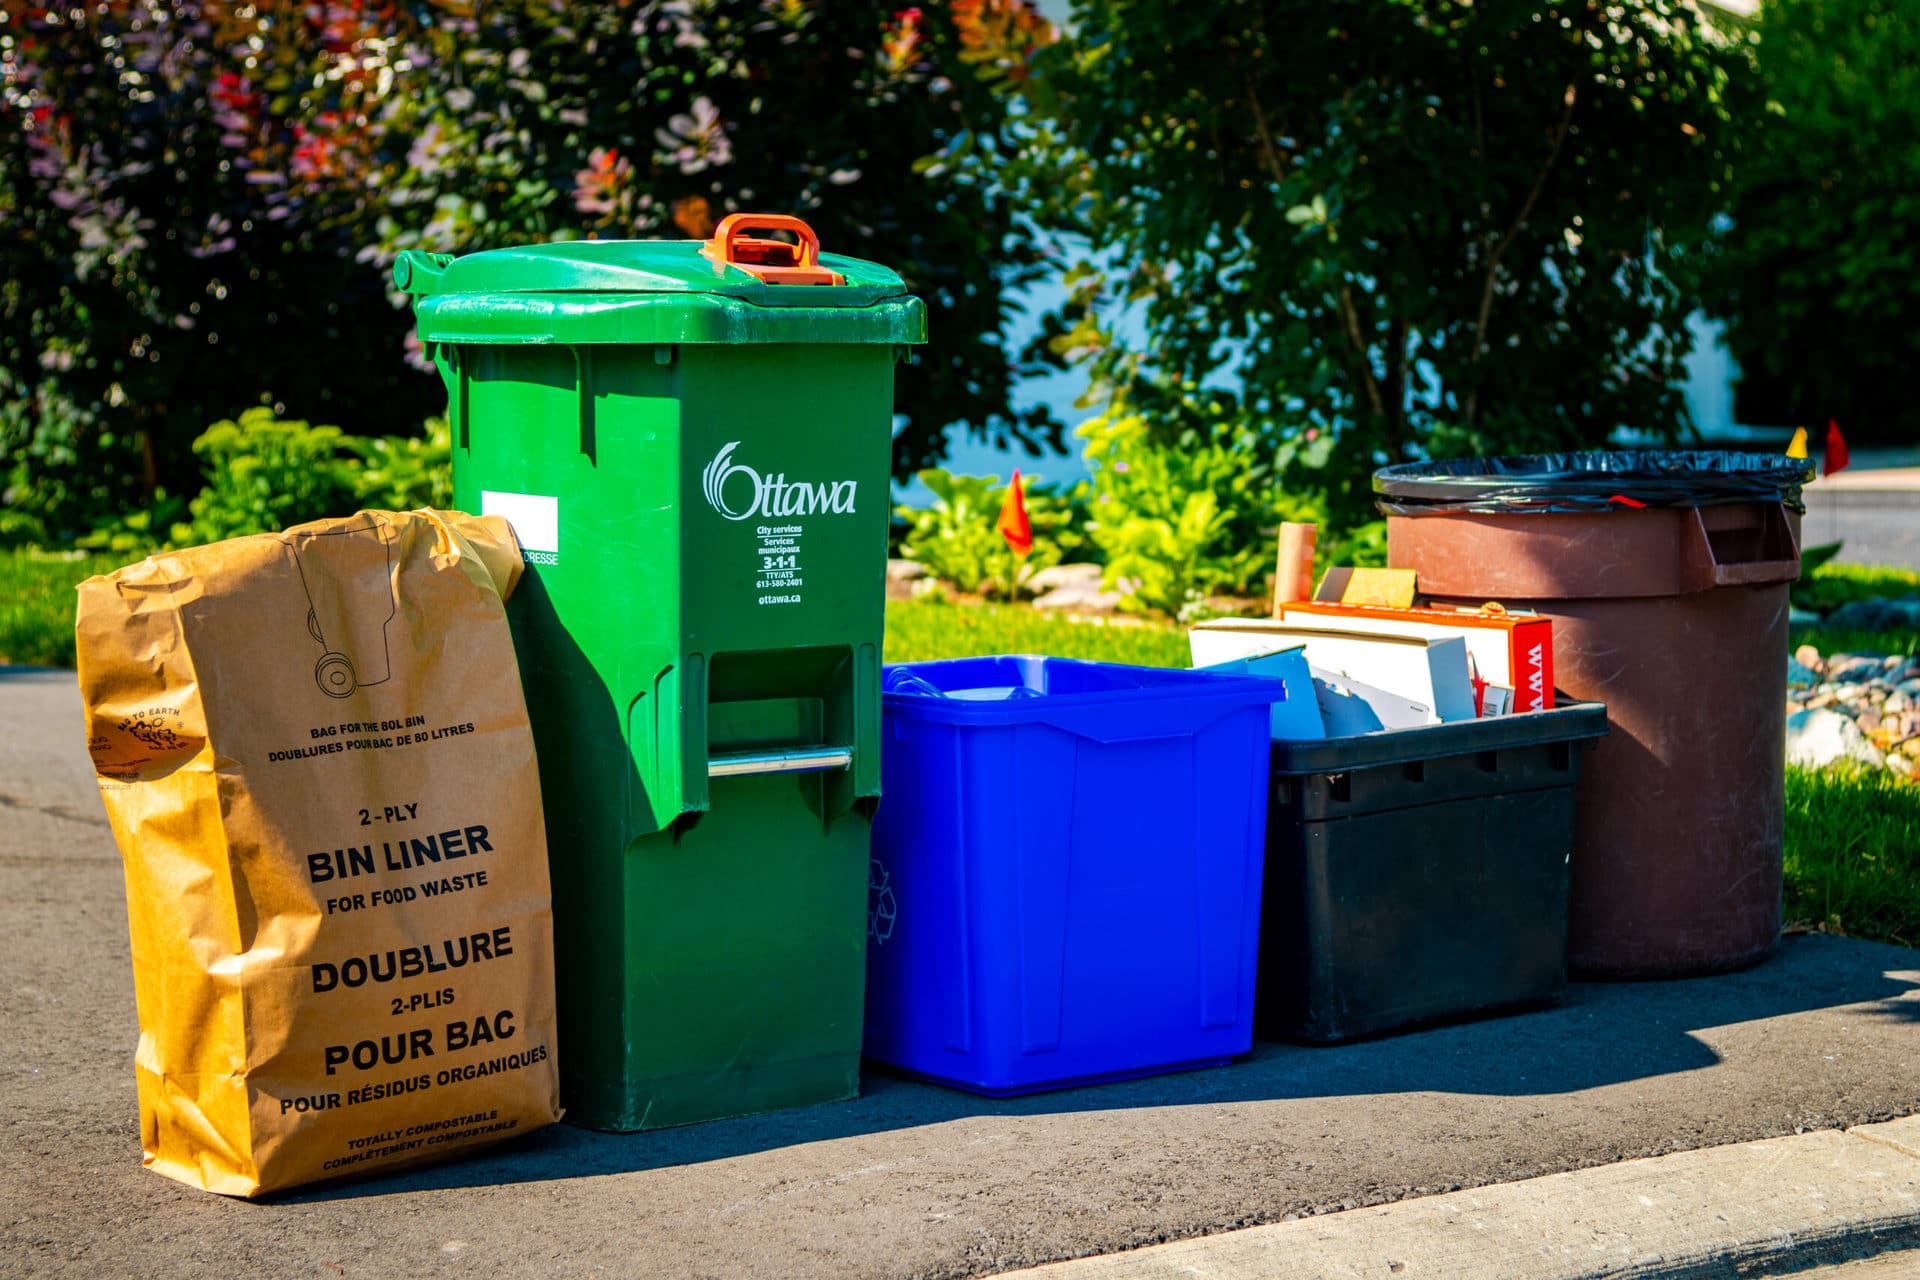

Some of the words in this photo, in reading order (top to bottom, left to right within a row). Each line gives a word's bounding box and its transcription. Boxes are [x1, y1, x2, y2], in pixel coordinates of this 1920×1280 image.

[703, 444, 857, 521] Ottawa
[756, 525, 772, 536] City
[773, 524, 802, 534] services
[763, 537, 794, 546] Services
[524, 552, 559, 566] DRESSE
[758, 545, 801, 555] municipaux
[763, 555, 796, 569] 3-1-1
[756, 578, 803, 588] 613-580-2401
[766, 571, 794, 580] TTY/ATS
[758, 594, 801, 605] ottawa.ca
[132, 711, 145, 721] TO
[148, 707, 180, 717] EARTH
[310, 725, 337, 739] BAG
[340, 722, 362, 734] FOR
[362, 722, 379, 732] THE
[405, 715, 425, 727] BIN
[269, 742, 344, 762] DOUBLURES
[346, 739, 373, 751] POUR
[373, 738, 393, 749] BAC
[396, 735, 412, 747] DE
[415, 732, 428, 743] 80
[432, 722, 475, 740] LITRES
[358, 802, 418, 826] 2-PLY
[307, 845, 376, 883] BIN
[383, 825, 494, 872] LINER
[327, 894, 366, 915] FOR
[371, 886, 417, 907] FOOD
[420, 870, 488, 897] WASTE
[312, 927, 513, 993] DOUBLURE
[391, 988, 455, 1015] 2-PLIS
[325, 1029, 435, 1076] POUR
[446, 1010, 515, 1052] BAC
[280, 1093, 341, 1115] POUR
[348, 1074, 431, 1105] RÉSIDUS
[437, 1045, 548, 1086] ORGANIQUES
[348, 1129, 402, 1150] TOTALLY
[406, 1110, 498, 1137] COMPOSTABLE
[427, 1119, 519, 1145] COMPOSTABLE
